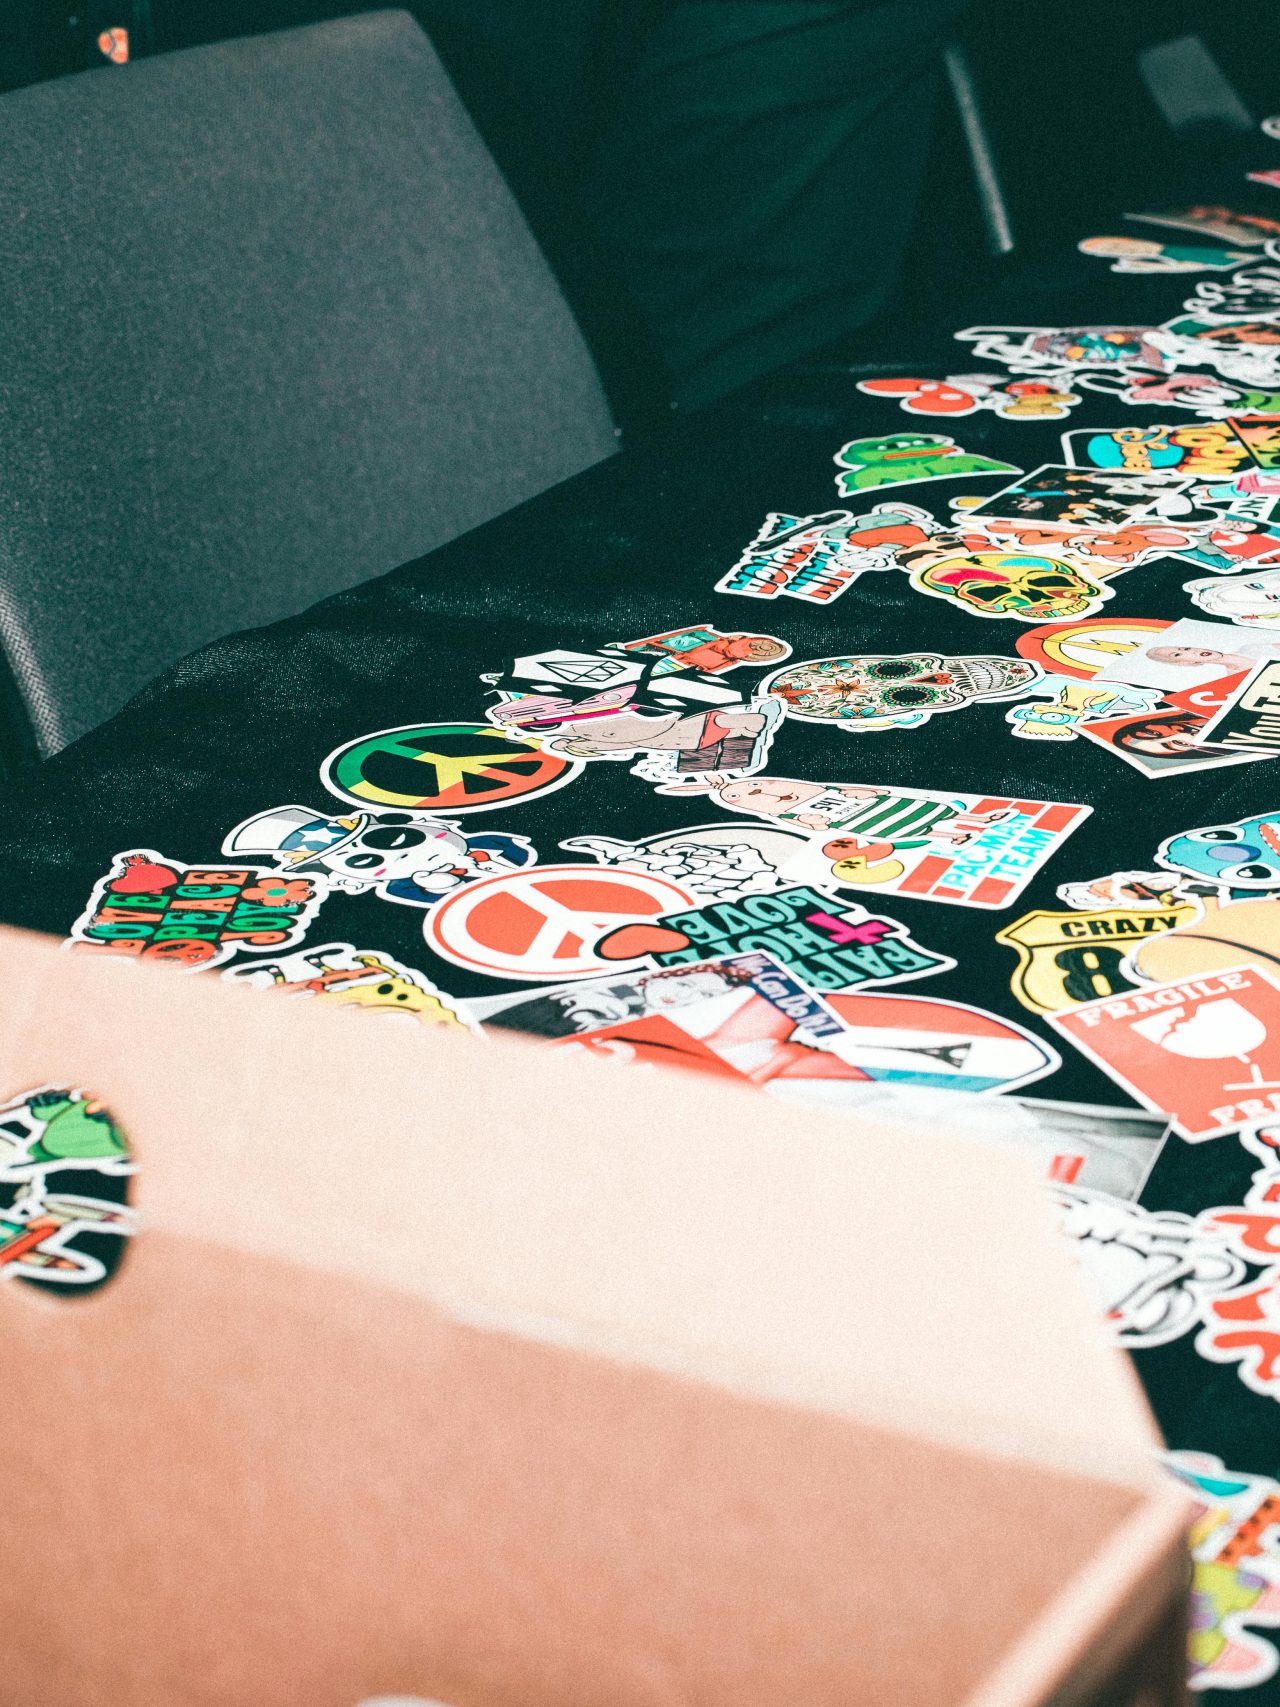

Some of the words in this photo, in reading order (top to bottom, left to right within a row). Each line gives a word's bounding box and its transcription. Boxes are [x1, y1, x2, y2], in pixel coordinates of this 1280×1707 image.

[988, 828, 1057, 878] TEAM
[153, 871, 250, 941] PEACE
[219, 902, 299, 945] JOY
[664, 888, 852, 944] LOVE
[1061, 916, 1177, 938] CRAZY
[662, 922, 841, 965] HO
[793, 939, 938, 989] FAIT
[752, 971, 790, 1000] Can
[775, 993, 813, 1018] Do
[1074, 972, 1253, 1028] FRAGILE
